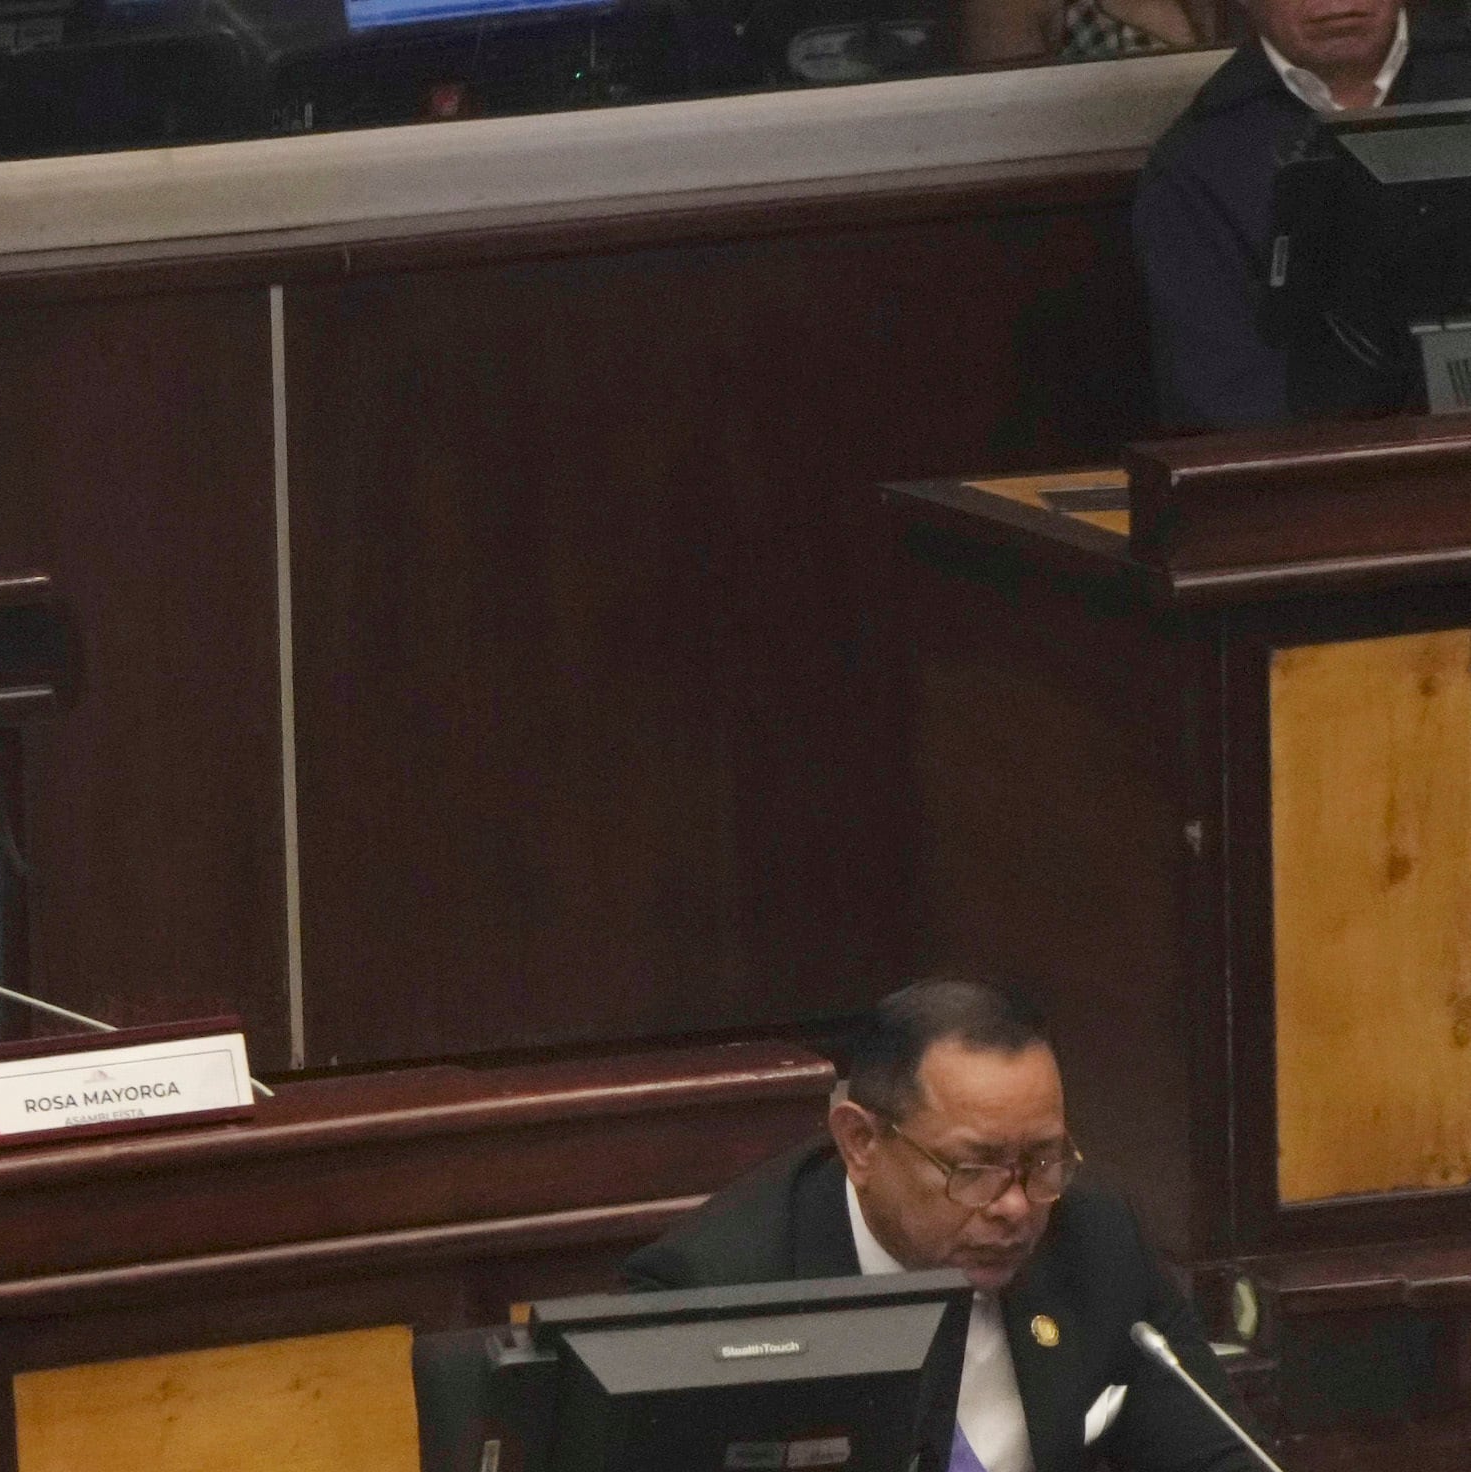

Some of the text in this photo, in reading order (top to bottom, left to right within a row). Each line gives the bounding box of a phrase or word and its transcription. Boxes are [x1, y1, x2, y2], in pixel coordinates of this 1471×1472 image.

[24, 1081, 181, 1113] ROSA MAYORGA
[722, 1342, 800, 1358] StealthTouch
